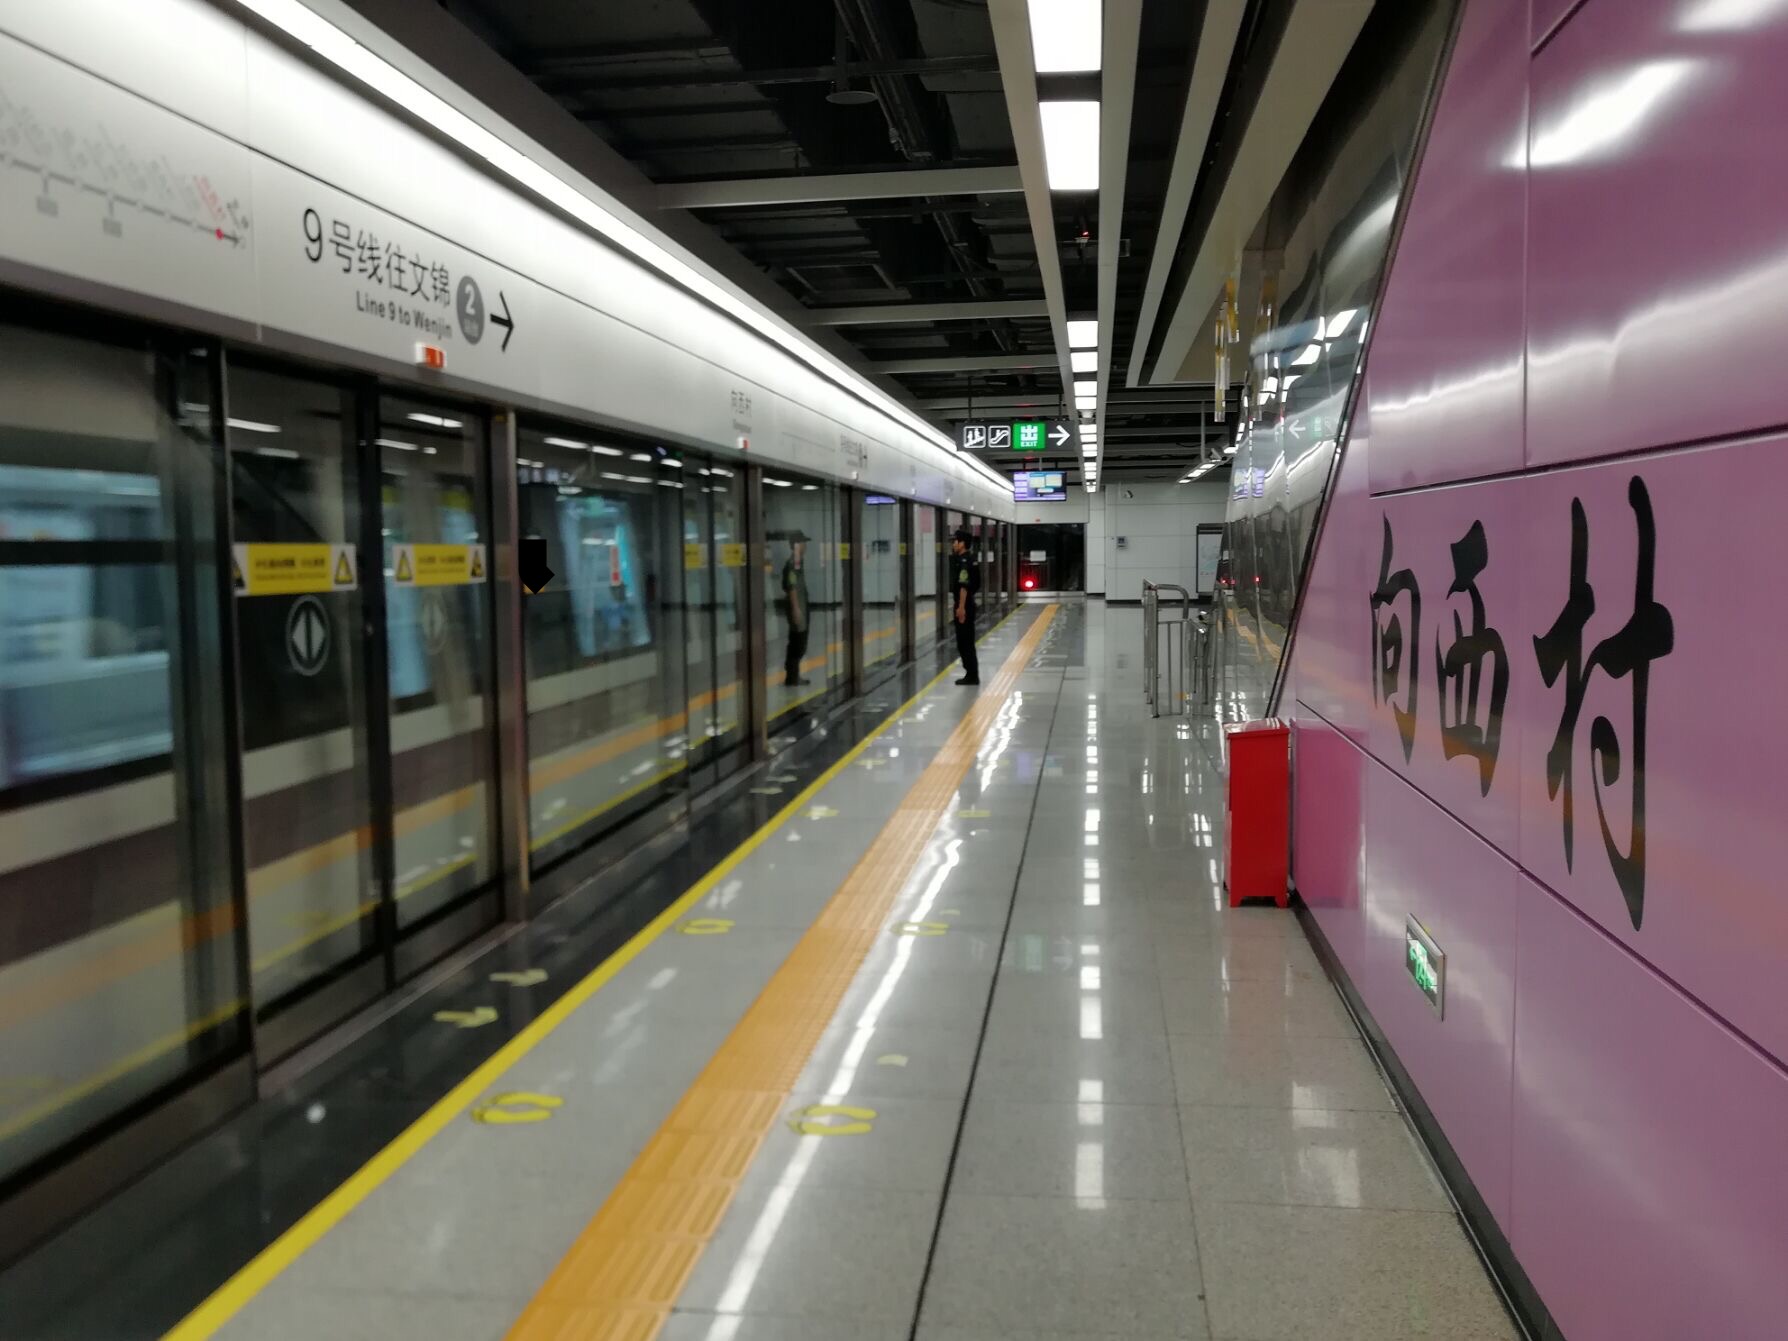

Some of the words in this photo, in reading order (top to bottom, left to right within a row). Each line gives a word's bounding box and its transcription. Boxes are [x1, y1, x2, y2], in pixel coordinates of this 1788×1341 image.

[303, 208, 451, 308] 9号线往文锦
[356, 291, 385, 318] Line
[388, 301, 396, 321] 9
[399, 306, 411, 325] to
[413, 309, 453, 340] Wenjin
[464, 283, 476, 315] 2
[1369, 475, 1674, 931] 向西村
